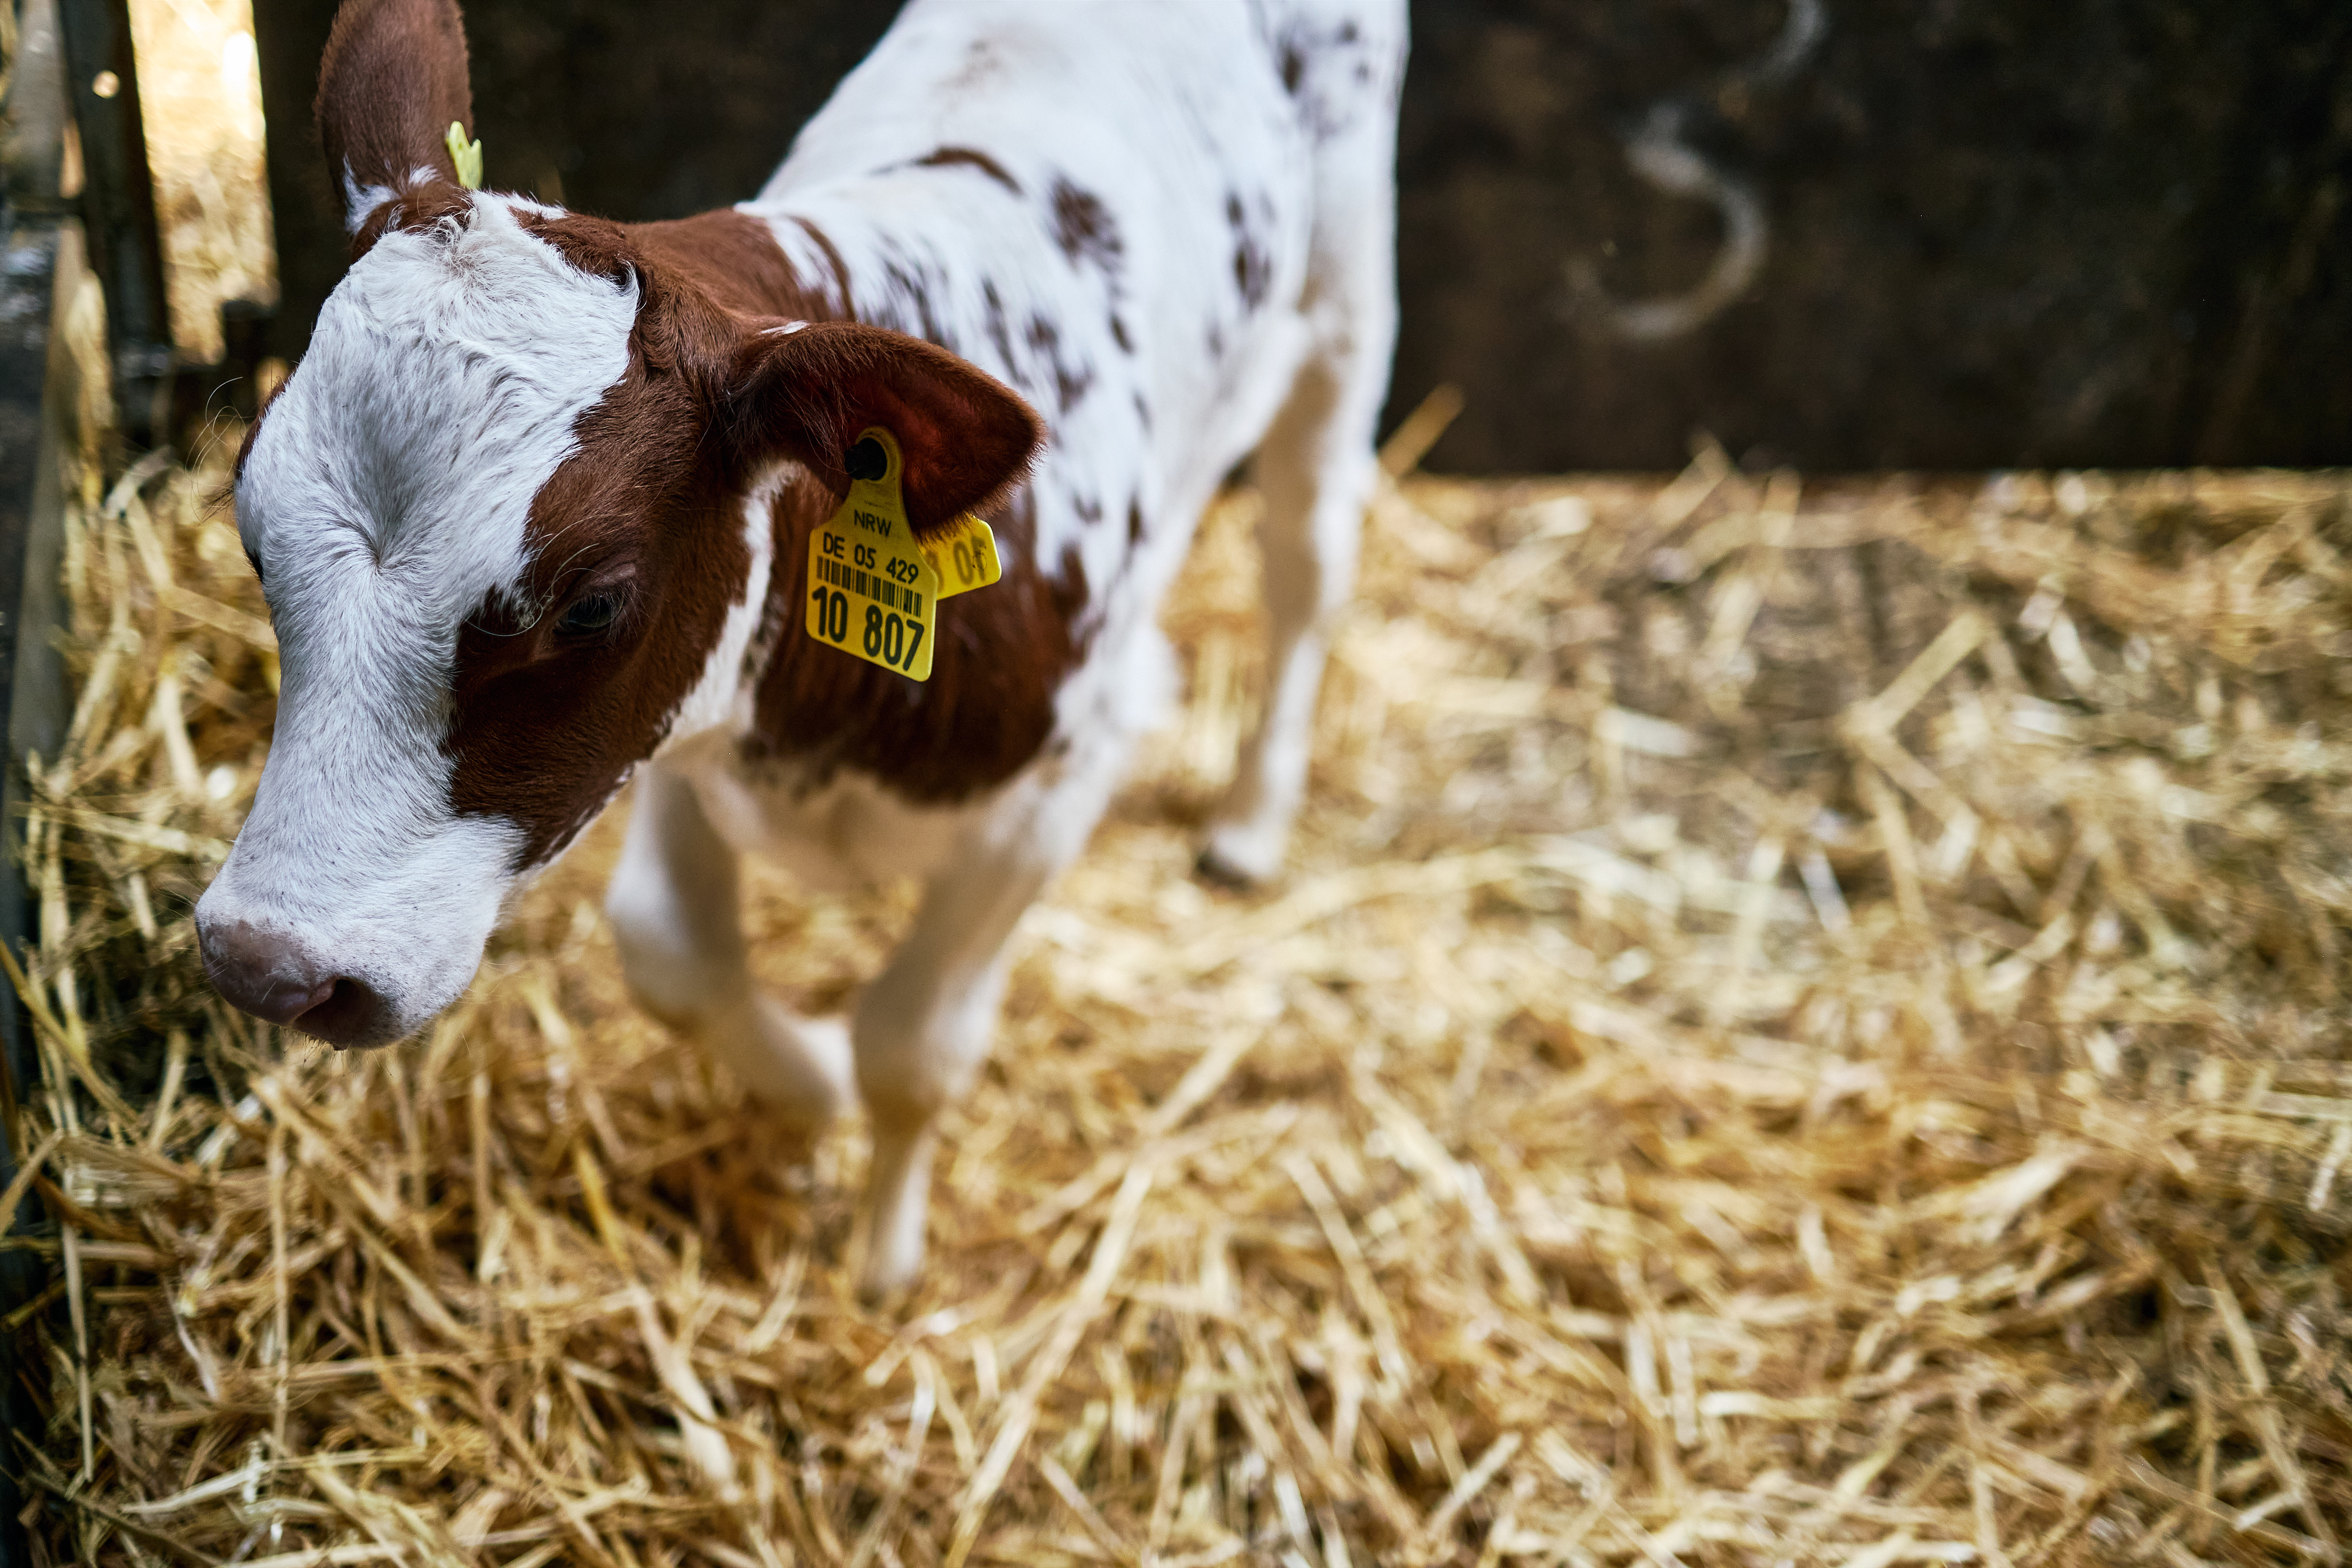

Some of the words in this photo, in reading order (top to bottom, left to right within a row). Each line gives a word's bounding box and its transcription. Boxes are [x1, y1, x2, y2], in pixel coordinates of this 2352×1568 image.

[854, 509, 891, 537] NRW
[823, 531, 845, 559] DE
[854, 544, 877, 570] 05
[886, 557, 919, 584] 429
[811, 586, 848, 643] 10
[864, 604, 924, 671] 807
